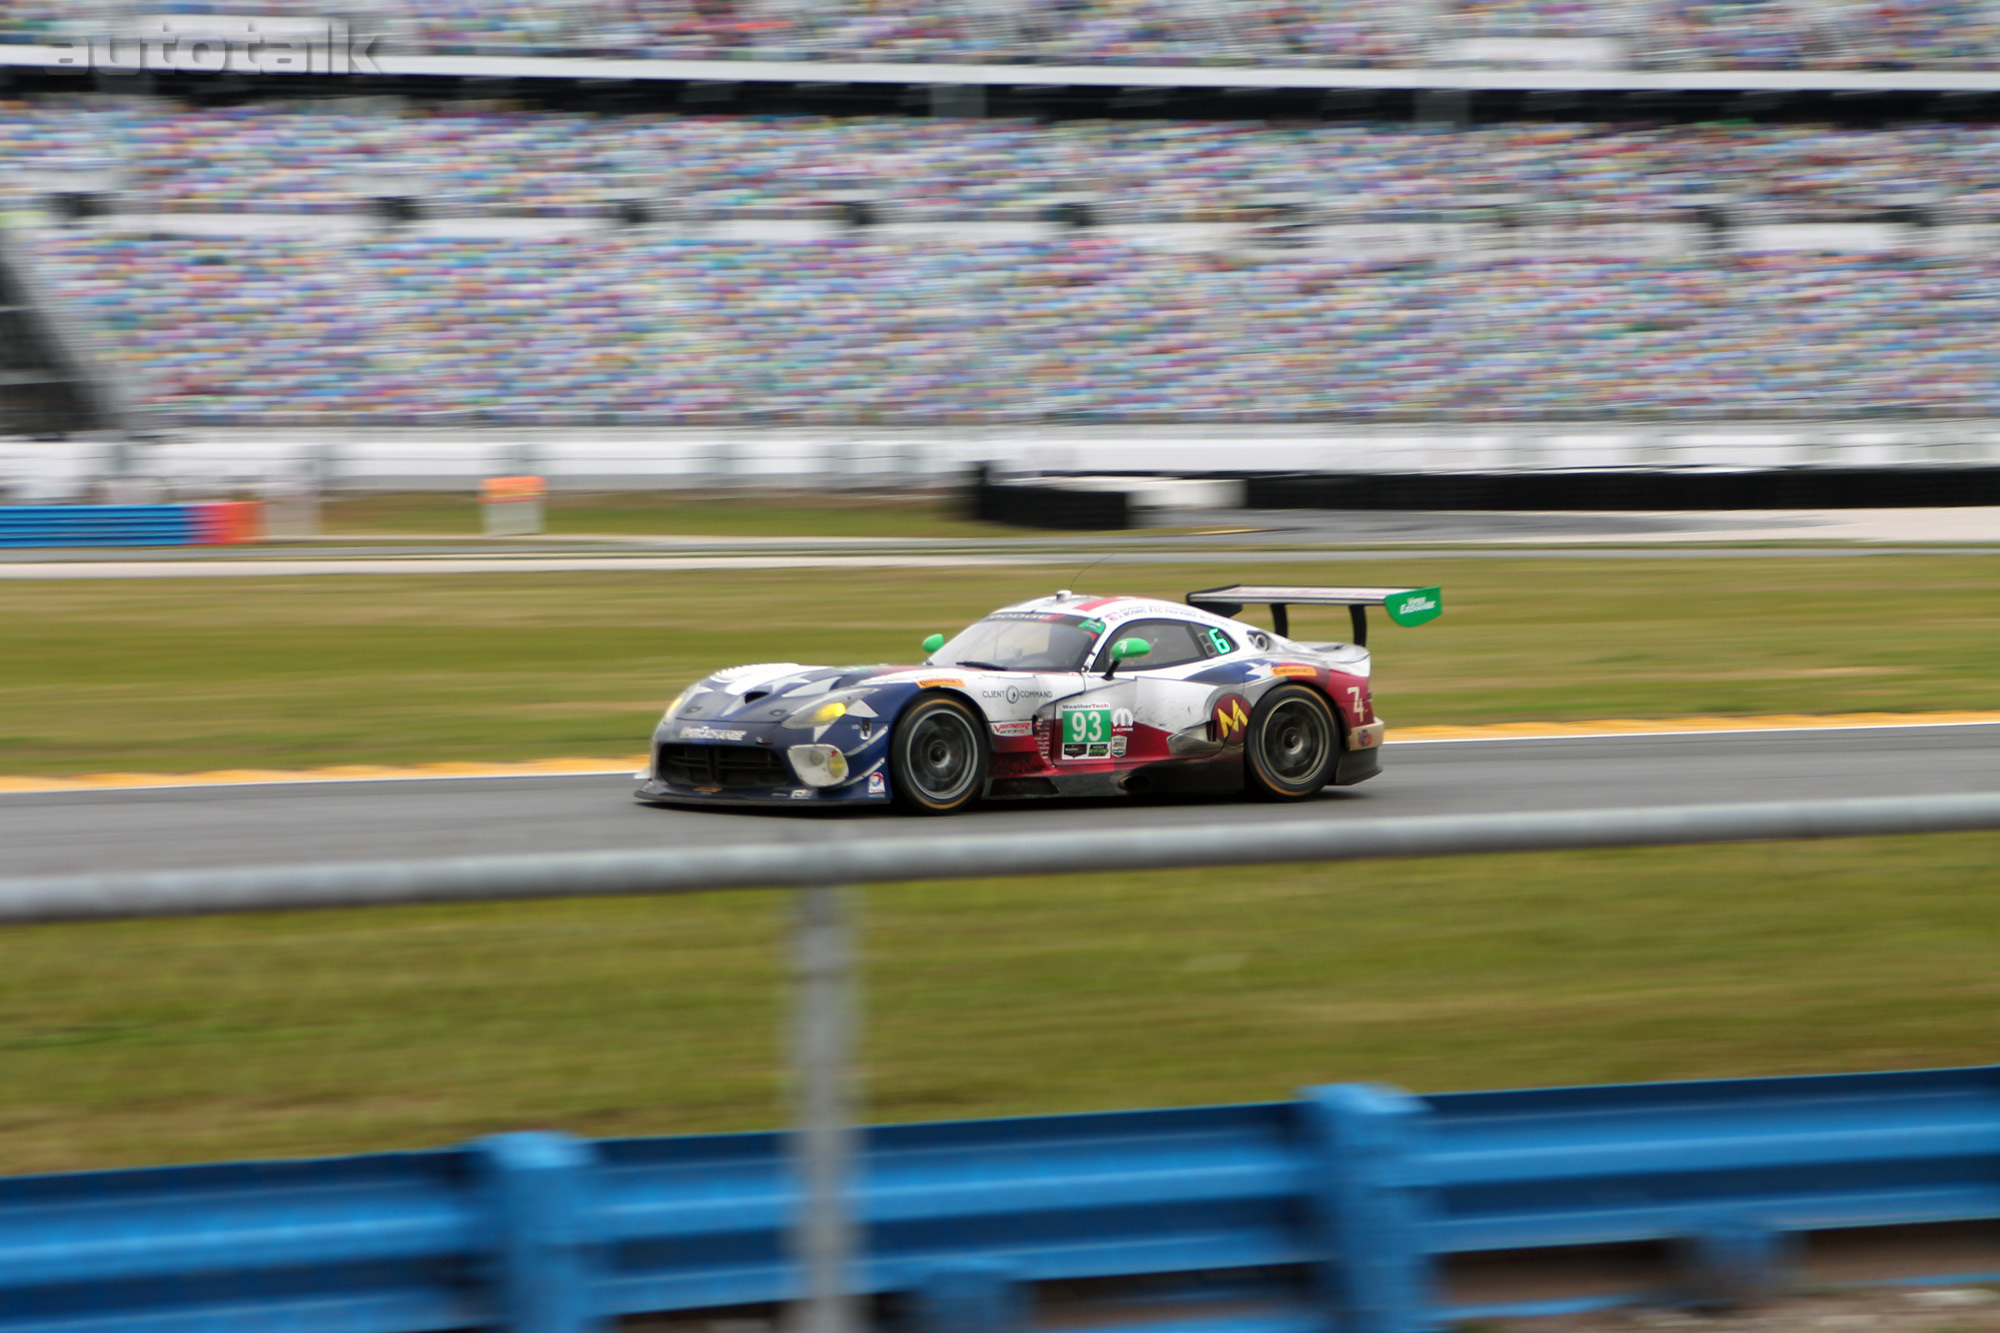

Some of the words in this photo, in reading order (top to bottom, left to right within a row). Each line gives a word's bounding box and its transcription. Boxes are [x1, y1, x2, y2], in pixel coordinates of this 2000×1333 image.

[1208, 628, 1231, 655] 6
[982, 690, 1005, 699] CLIENT
[1020, 690, 1053, 699] COMMAND
[1072, 711, 1103, 742] 93
